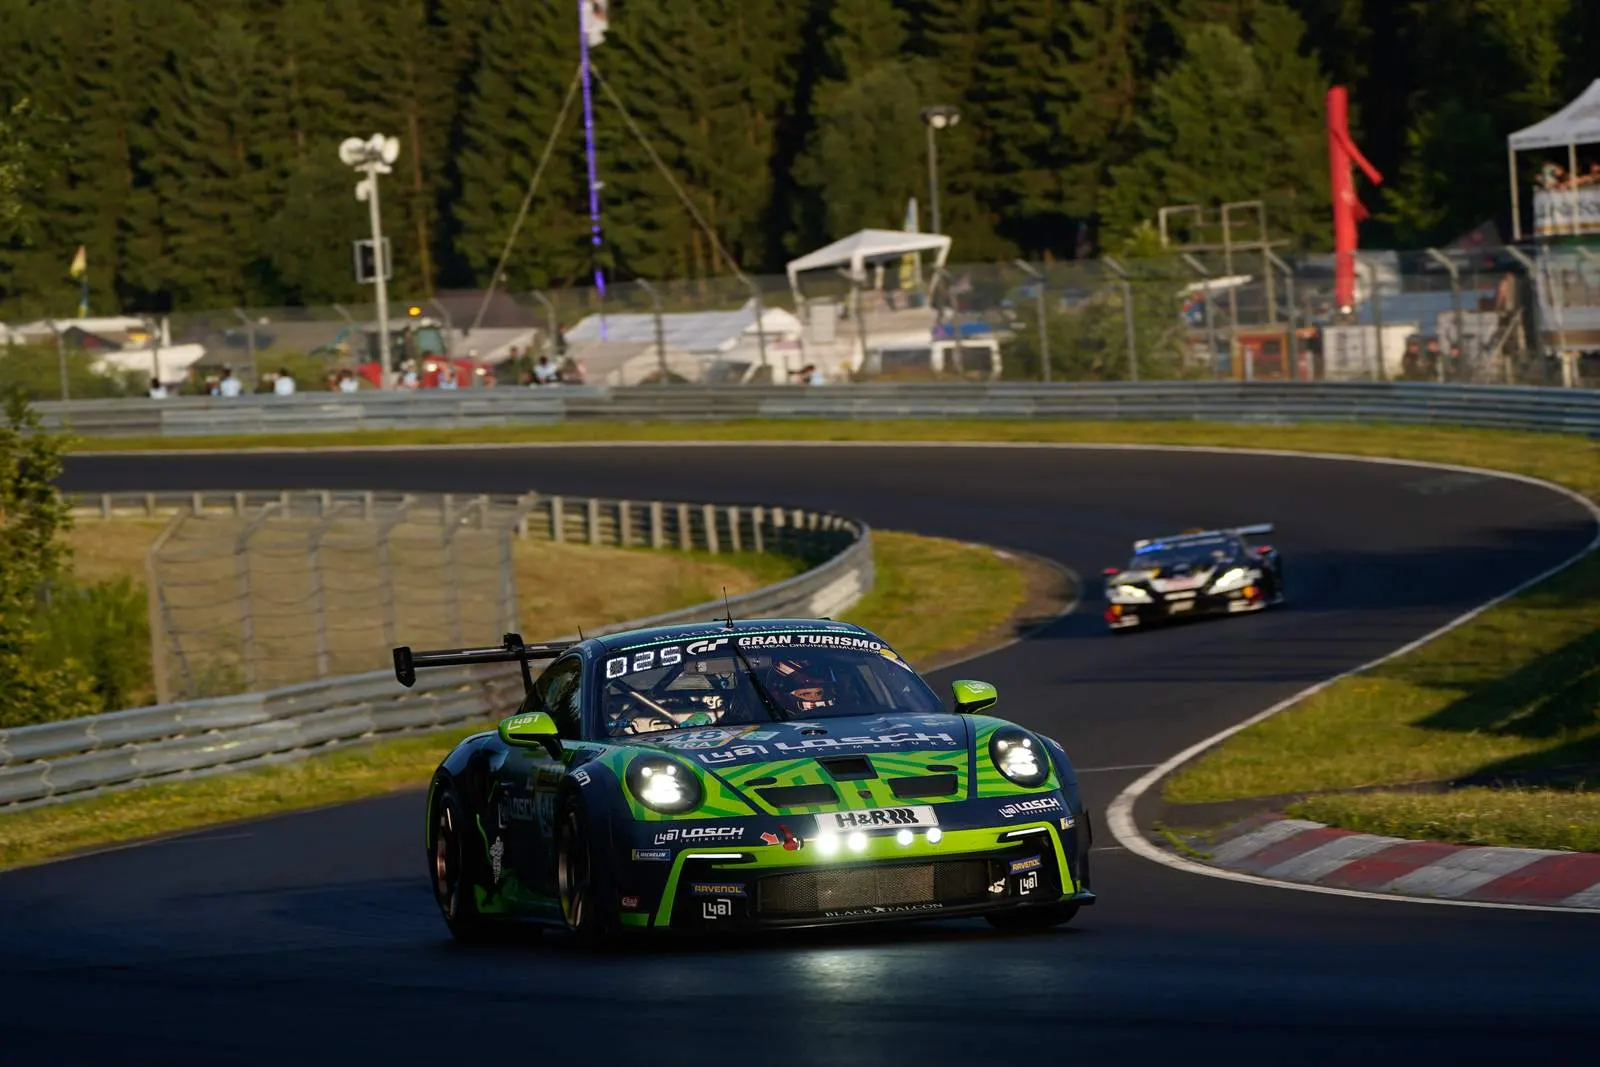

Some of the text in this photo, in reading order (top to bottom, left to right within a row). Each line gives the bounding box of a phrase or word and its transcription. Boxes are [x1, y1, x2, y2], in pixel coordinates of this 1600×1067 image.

[738, 635, 881, 651] GRAN TURISMO
[606, 646, 681, 679] 025
[774, 733, 953, 751] LOSCH
[1015, 798, 1060, 811] LOSCH
[681, 827, 744, 838] LOSCH
[1012, 859, 1040, 871] RAVENOL
[694, 885, 743, 893] RAVENOL
[824, 902, 943, 918] BLACK FALCON
